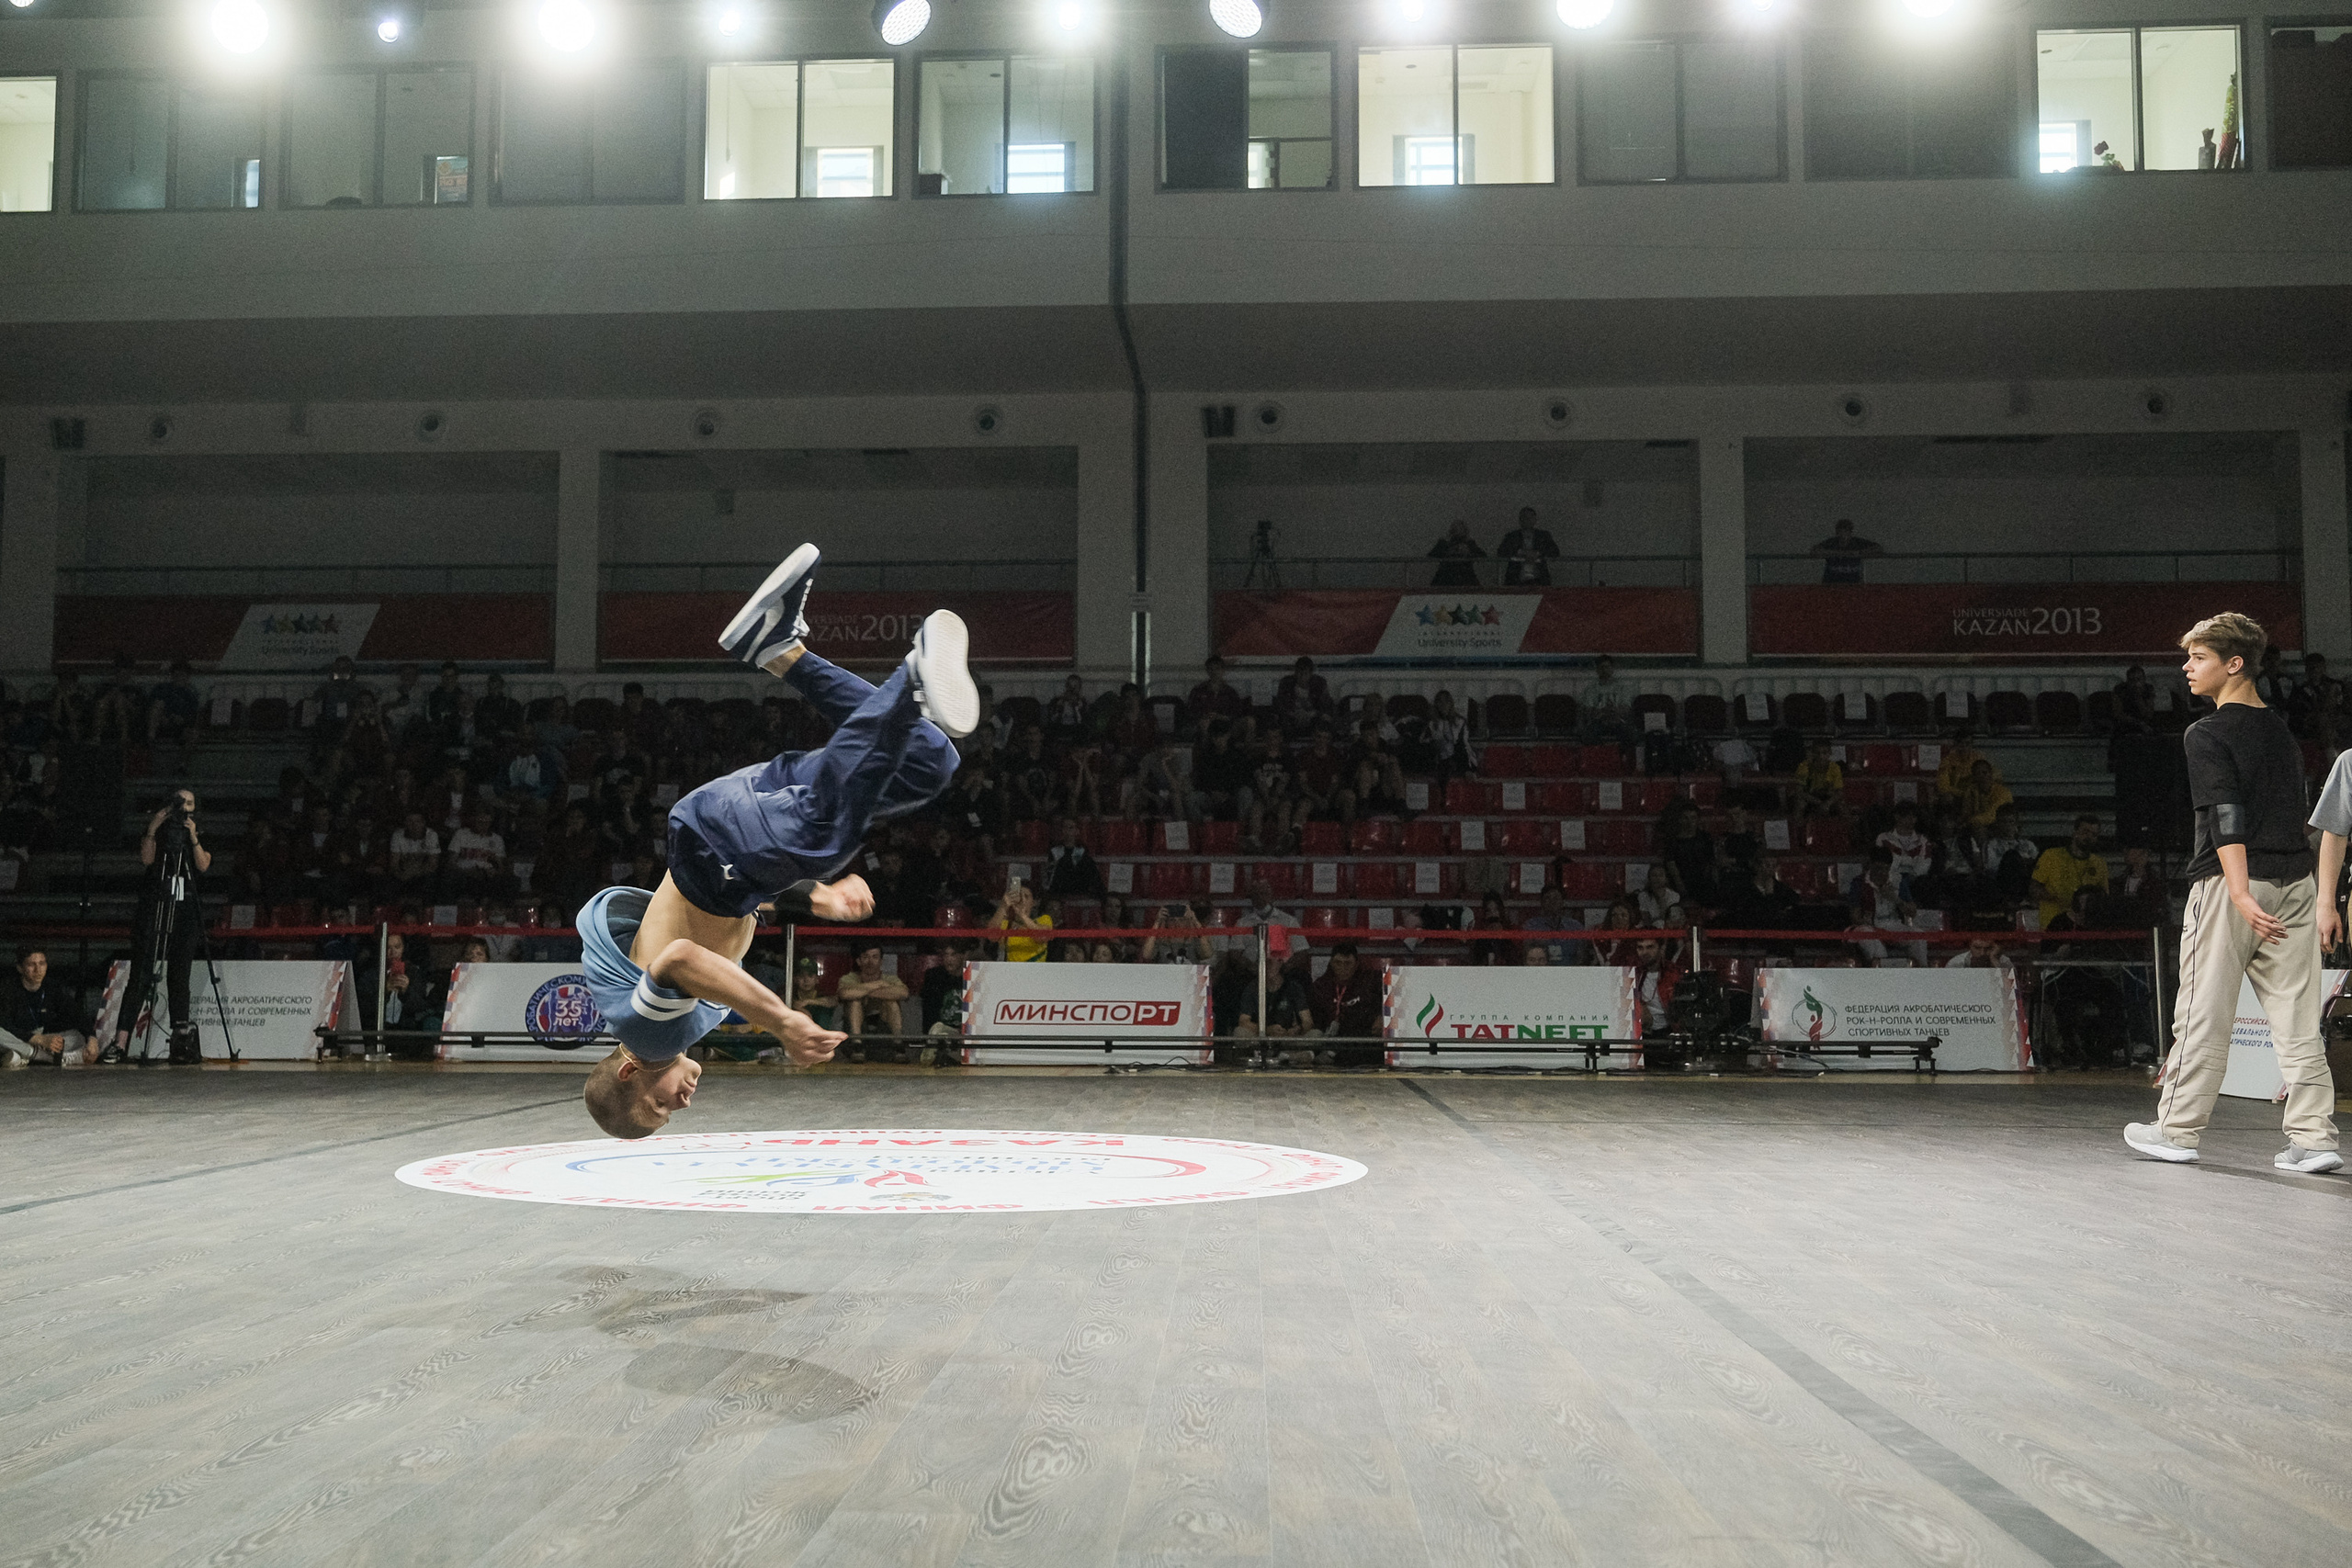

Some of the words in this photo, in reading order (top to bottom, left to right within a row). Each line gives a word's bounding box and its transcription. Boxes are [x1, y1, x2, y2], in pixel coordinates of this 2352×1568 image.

[1952, 608, 2028, 618] UNIVERSIADE
[1953, 619, 2030, 636] KAZAN
[2031, 607, 2102, 635] 2013
[1418, 638, 1467, 648] University
[1469, 638, 1501, 648] Sports
[231, 996, 312, 1004] АКРОБАТИЧЕСКОГО
[238, 1007, 245, 1015] И
[247, 1007, 311, 1015] СОВРЕМЕННЫХ
[555, 1000, 582, 1018] 35
[1000, 1004, 1177, 1021] МИНСПОРТ
[1845, 1005, 1900, 1014] ФЕДЕРАЦИЯ
[1903, 1004, 1992, 1013] АКРОБАТИЧЕСКОГО
[233, 1018, 266, 1027] ТАНЦЕВ
[553, 1017, 579, 1026] лет
[1847, 1016, 1912, 1024] РОК-Н-РОЛЛА
[1926, 1016, 1996, 1024] СОВРЕМЕННЫХ
[2233, 1017, 2269, 1025] ЕРОССИЙСКА
[1451, 1024, 1609, 1039] TATNEFT
[1849, 1028, 1911, 1037] СПОРТИВНЫХ
[1914, 1028, 1950, 1036] ТАНЦЕВ
[560, 1196, 748, 1209] ФИНАЛ
[1087, 1191, 1249, 1205] ФИНАЛ
[812, 1203, 1023, 1212] ФИНАЛ
